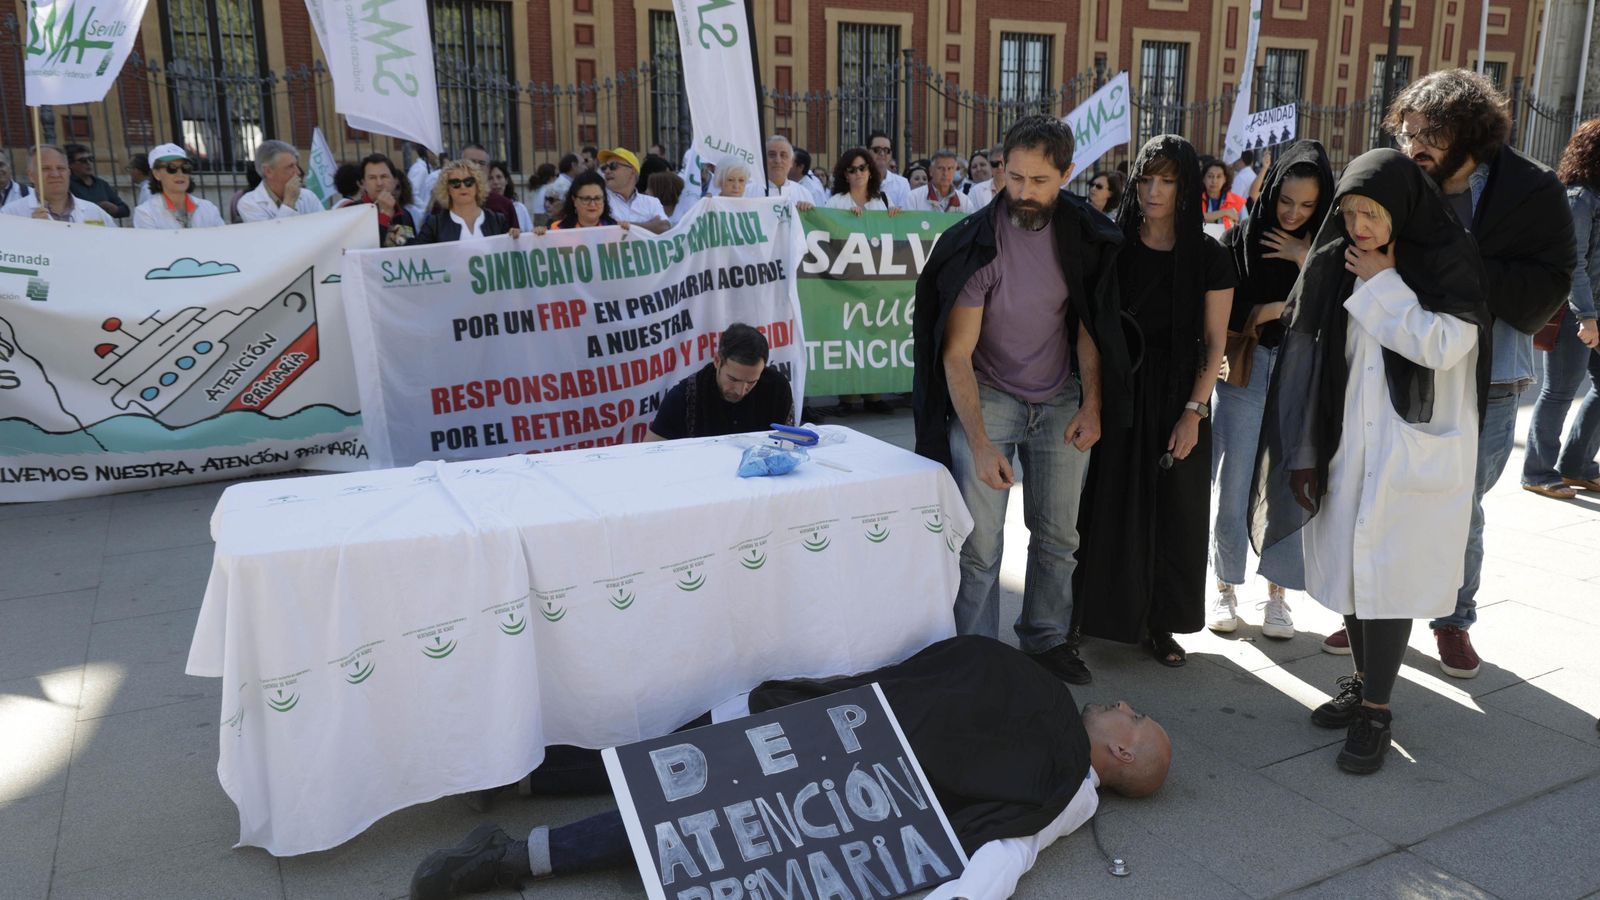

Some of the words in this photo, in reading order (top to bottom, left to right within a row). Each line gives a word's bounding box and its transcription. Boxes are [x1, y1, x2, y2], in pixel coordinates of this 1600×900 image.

[1257, 105, 1294, 127] SANIDAD
[468, 244, 593, 295] SINDICATO
[453, 313, 500, 342] POR
[503, 310, 536, 335] UN
[537, 298, 587, 332] FRP
[594, 302, 622, 324] EN
[625, 269, 714, 320] PRIMARIA
[718, 259, 787, 290] ACORDE
[587, 335, 604, 358] A
[606, 309, 694, 355] NUESTRA
[431, 346, 677, 415] RESPONSABILIDAD
[680, 339, 692, 366] Y
[430, 425, 478, 452] POR
[483, 422, 508, 446] EL
[511, 398, 635, 443] RETRASO
[96, 460, 195, 482] NUESTRA
